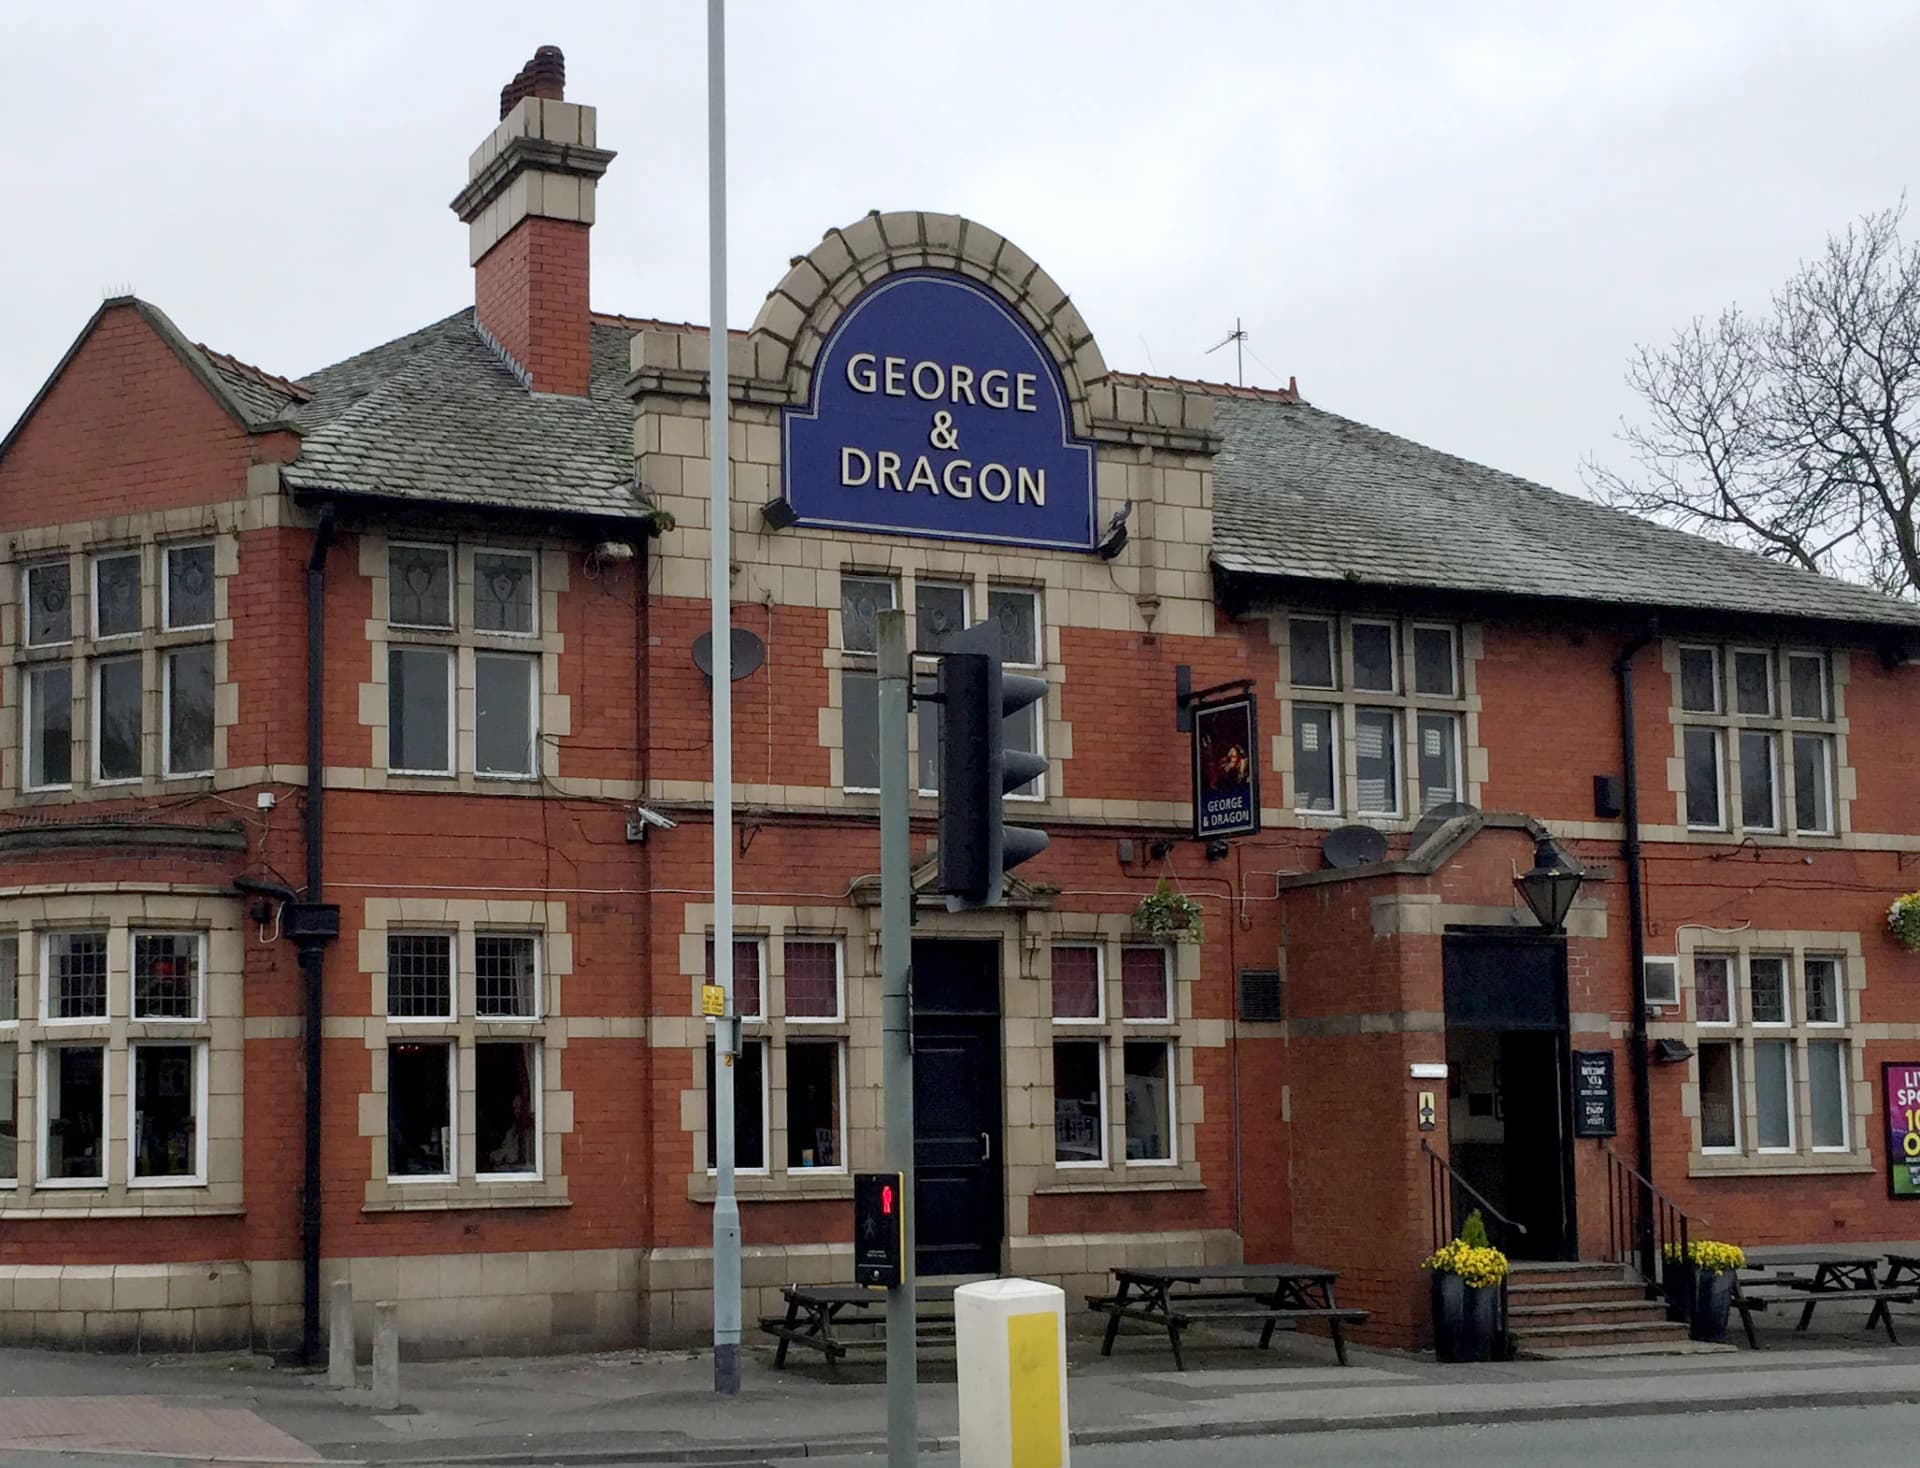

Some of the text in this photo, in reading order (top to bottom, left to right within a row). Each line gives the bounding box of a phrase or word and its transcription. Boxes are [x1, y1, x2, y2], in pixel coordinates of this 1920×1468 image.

[846, 353, 1037, 412] GEORGE
[930, 410, 959, 450] &
[841, 447, 1046, 506] DRAGON
[1208, 796, 1243, 812] GEORGE
[1203, 810, 1249, 827] & DRAGON
[1905, 1071, 1920, 1087] LI
